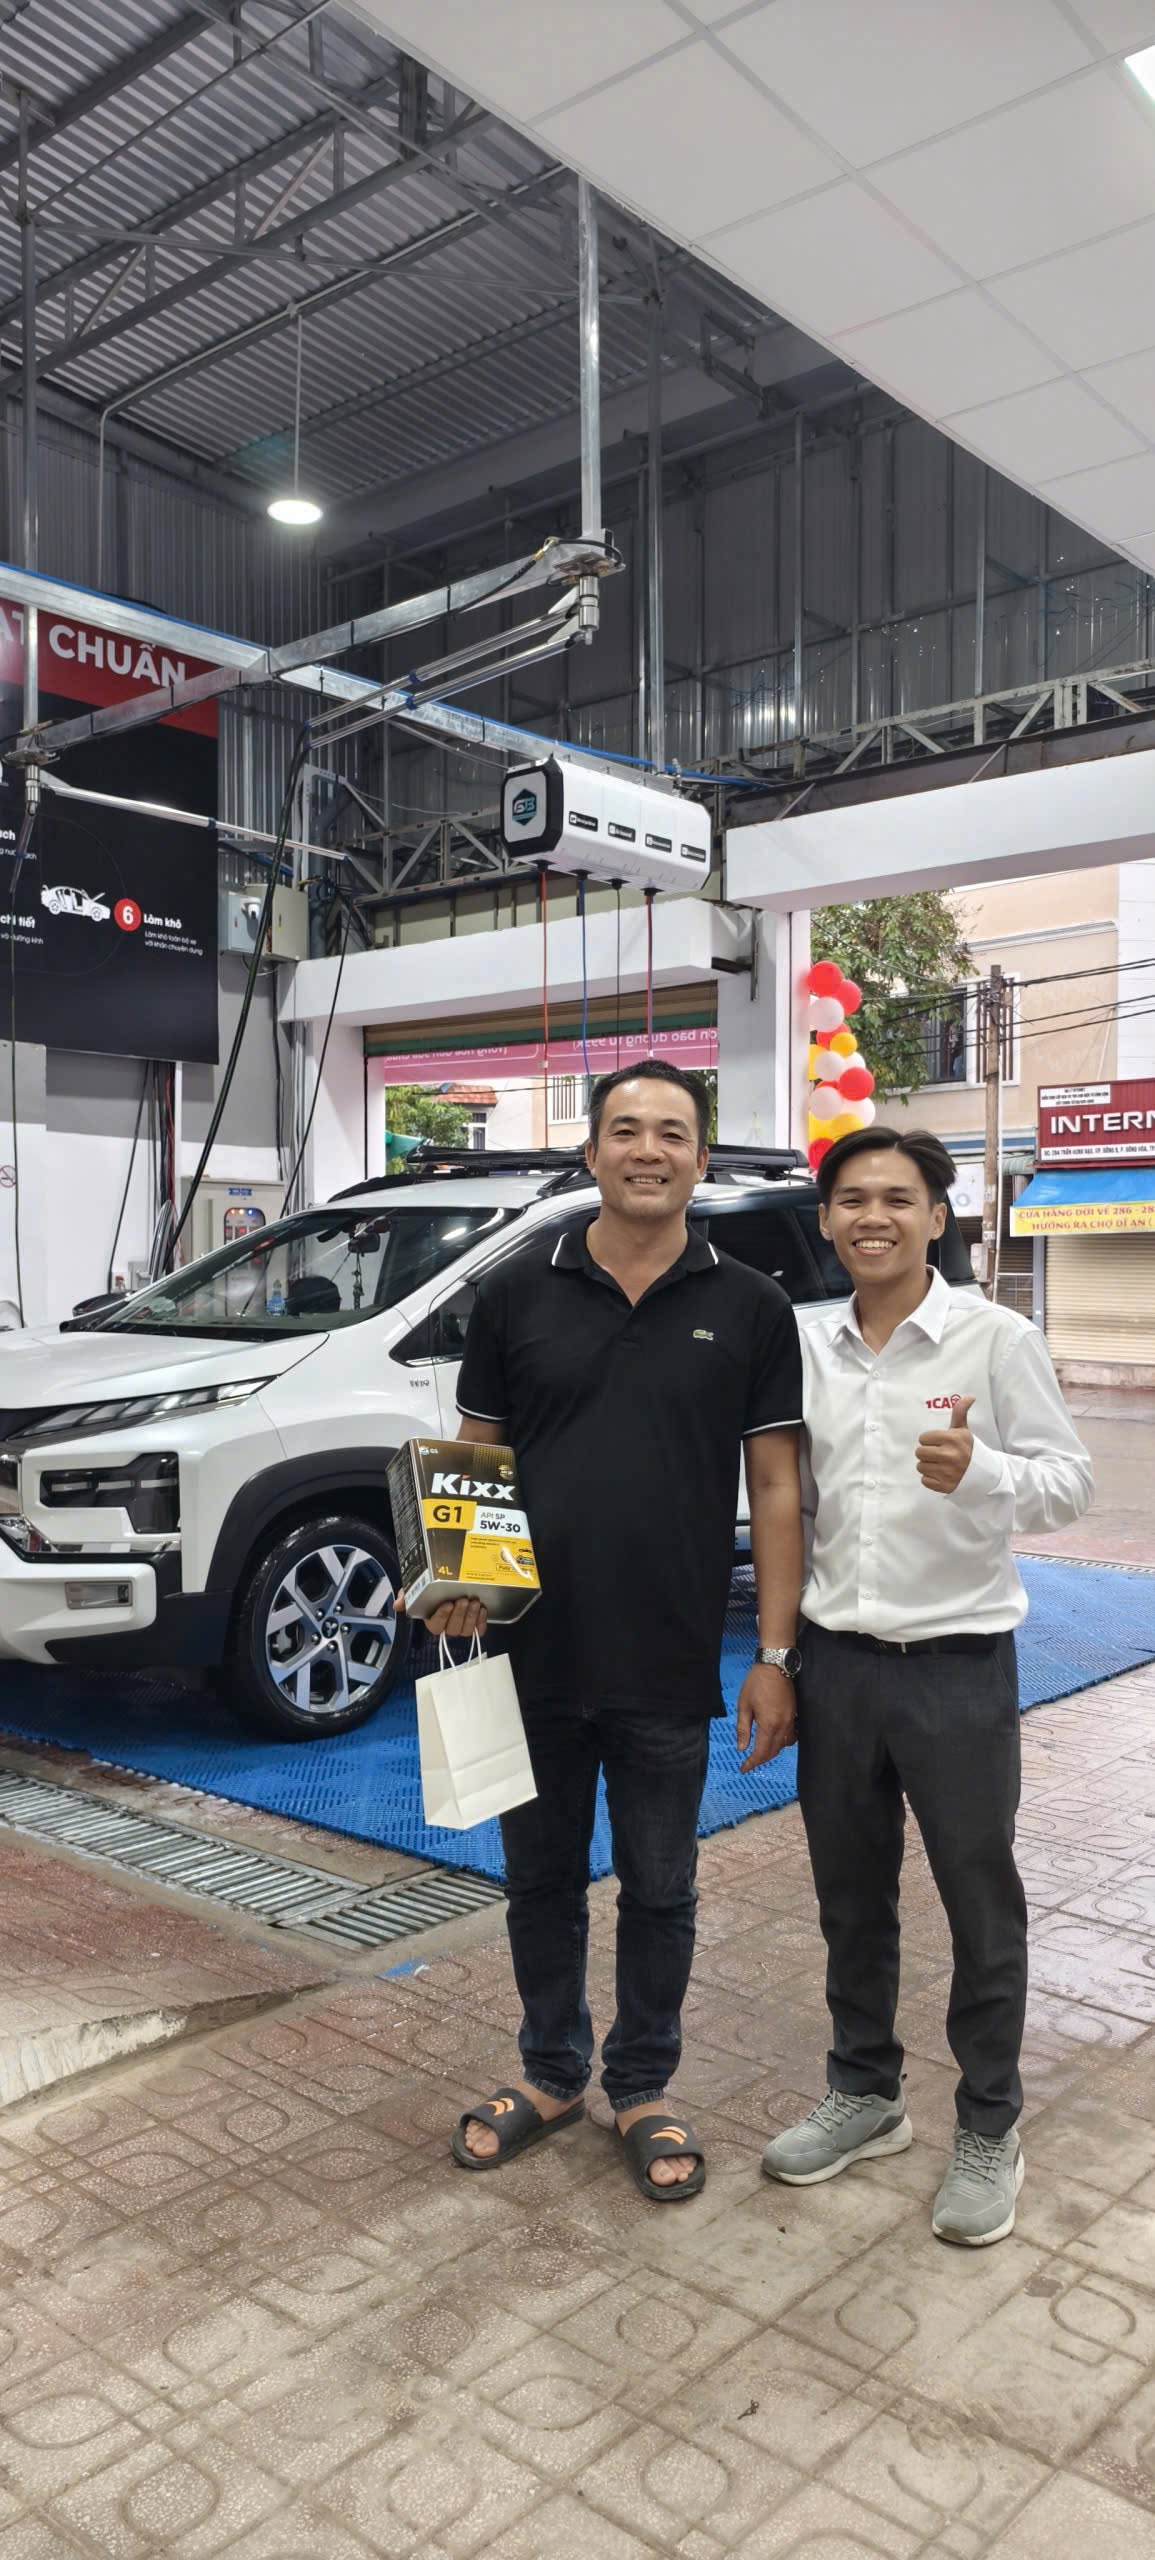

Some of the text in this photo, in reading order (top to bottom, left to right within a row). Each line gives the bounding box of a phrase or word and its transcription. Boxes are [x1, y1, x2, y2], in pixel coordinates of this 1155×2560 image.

[122, 905, 134, 925] 6
[143, 913, 182, 929] Làm khô
[1112, 1206, 1133, 1215] 286
[1073, 1220, 1088, 1229] RA
[1130, 1218, 1146, 1227] AN
[431, 1472, 515, 1501] Kixx
[432, 1504, 462, 1523] G1
[481, 1511, 494, 1519] API
[480, 1520, 521, 1533] 5W-30
[438, 1566, 453, 1575] 4L
